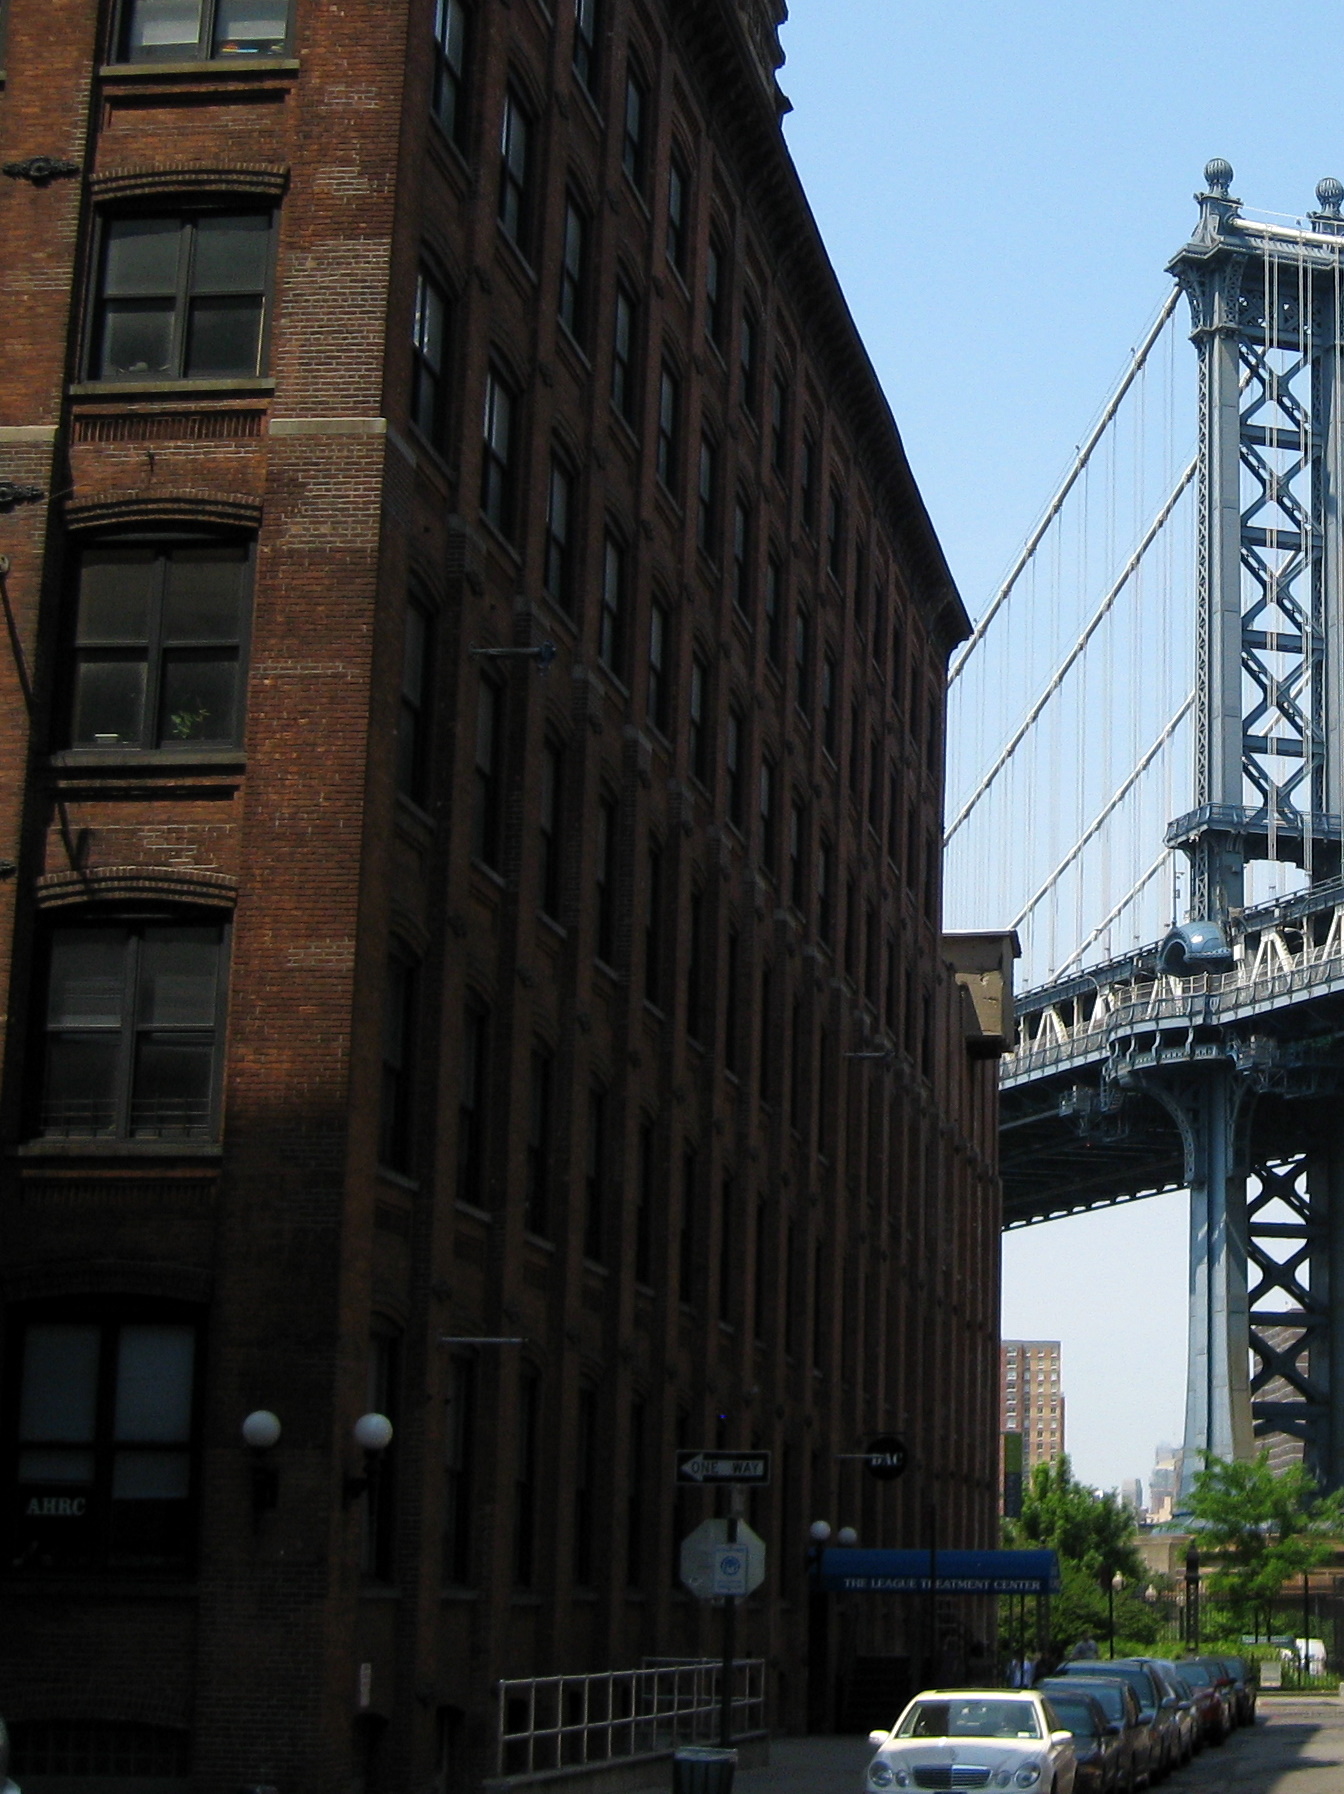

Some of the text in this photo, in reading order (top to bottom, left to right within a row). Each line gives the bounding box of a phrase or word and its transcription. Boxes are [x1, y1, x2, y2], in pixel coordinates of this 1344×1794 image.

[691, 1461, 759, 1474] ONE WAY
[25, 1496, 87, 1517] AHRC
[844, 1578, 866, 1588] THE
[871, 1578, 917, 1589] LEAGUE
[994, 1580, 1040, 1590] CENTER
